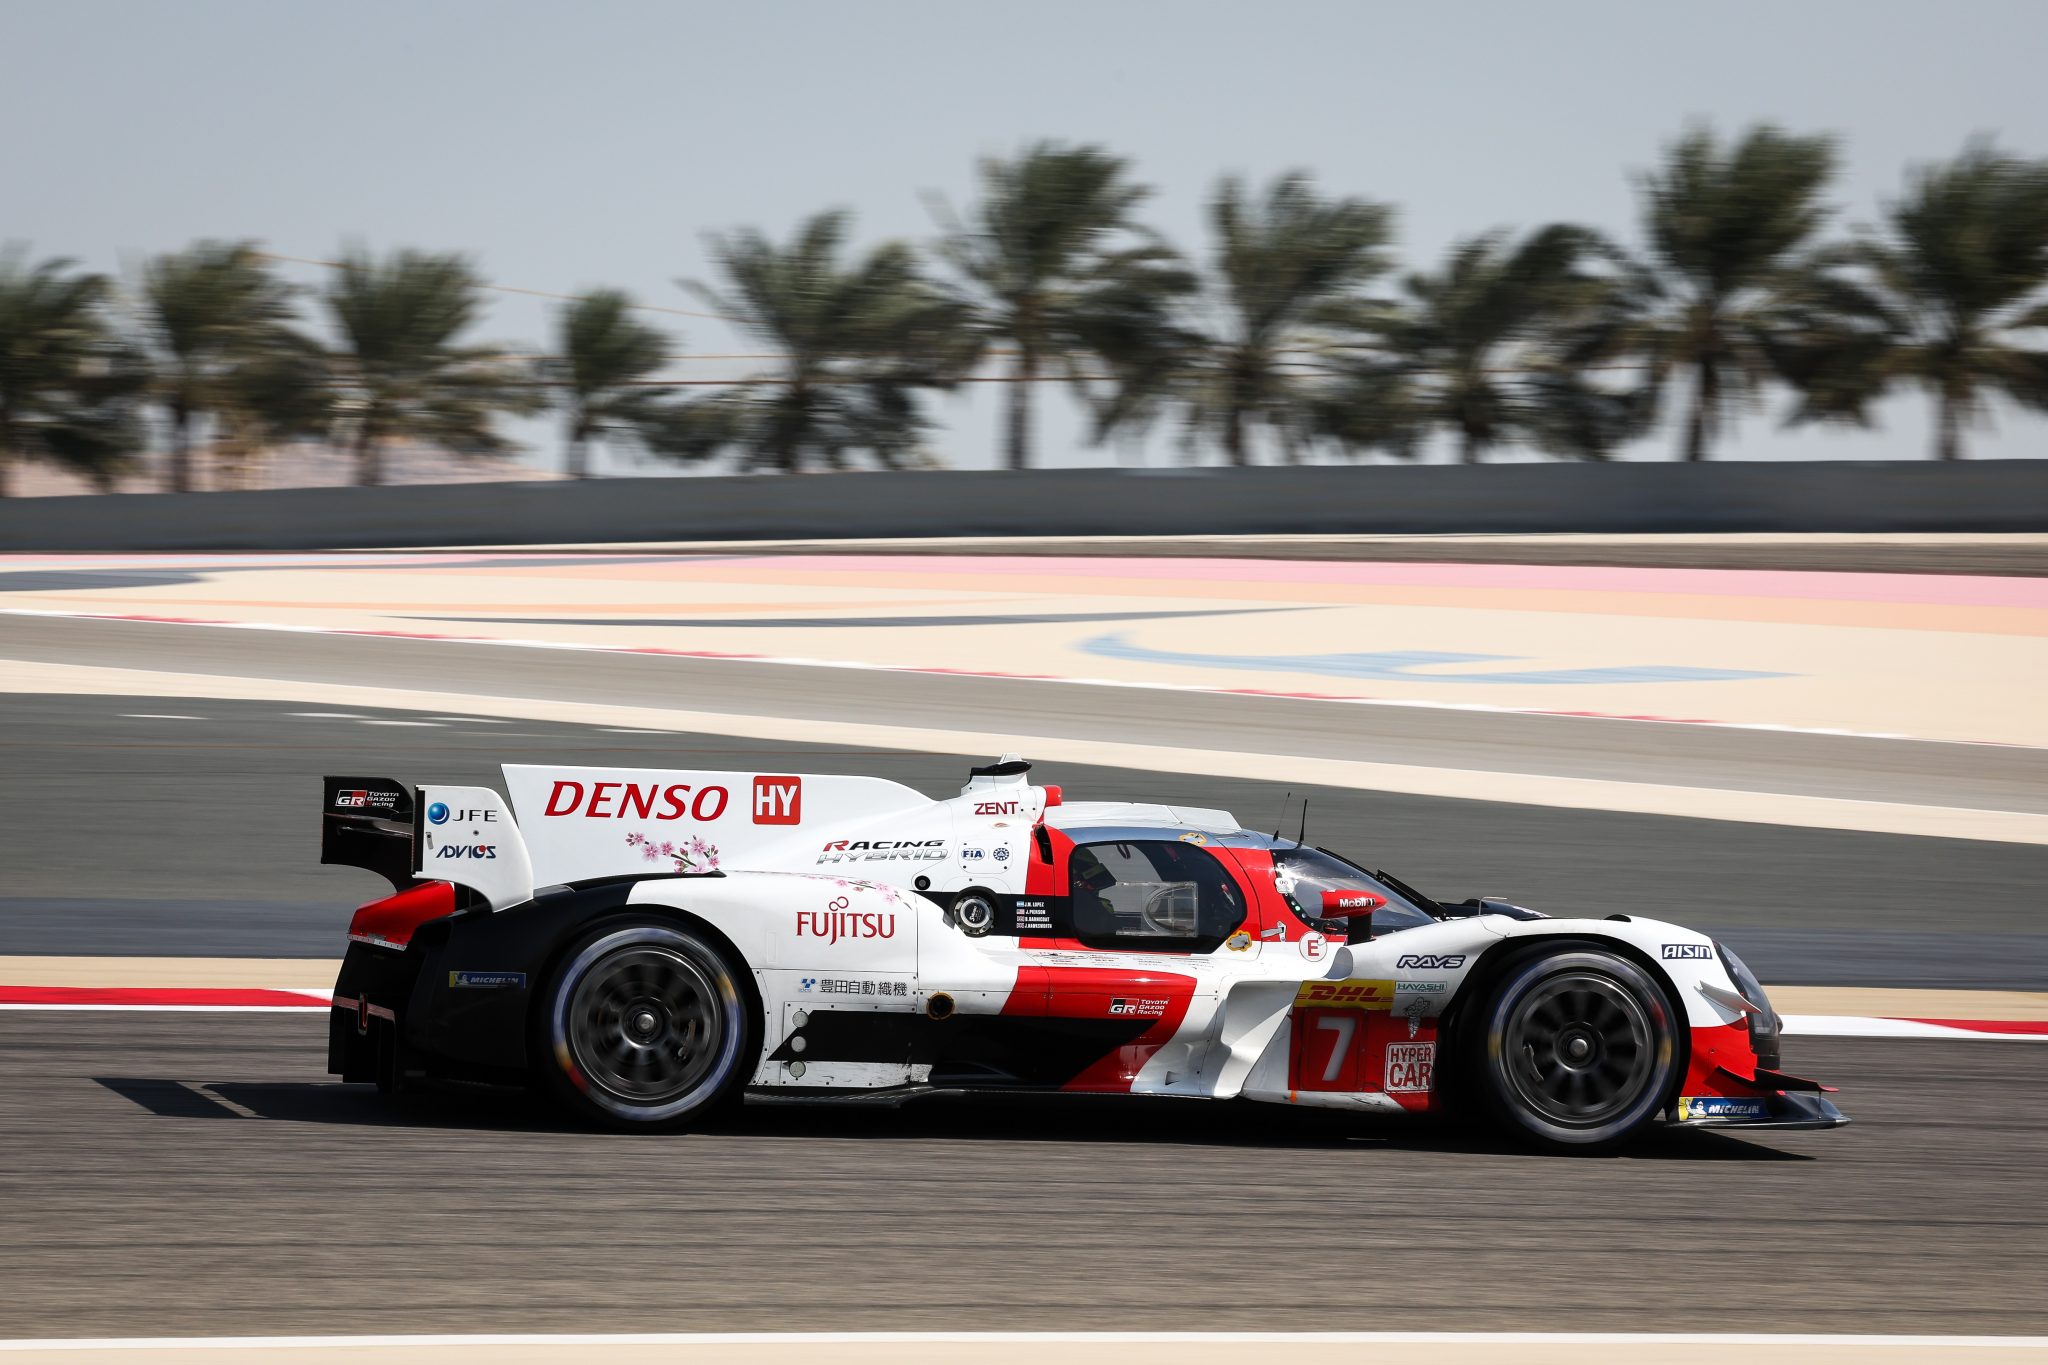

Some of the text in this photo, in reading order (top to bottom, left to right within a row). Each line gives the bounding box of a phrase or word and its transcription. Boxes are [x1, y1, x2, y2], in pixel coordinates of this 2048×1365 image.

[337, 796, 364, 805] GR
[544, 780, 729, 821] DENSO
[755, 783, 796, 817] HY
[452, 809, 498, 822] JFE
[973, 801, 1019, 815] ZENT
[436, 845, 497, 859] ADVICS
[822, 839, 946, 852] RACING
[815, 848, 949, 865] HYBRID
[1339, 897, 1366, 908] Mobil
[796, 911, 895, 946] FUJITSU
[1307, 939, 1320, 957] E
[1663, 944, 1712, 959] AISIN
[1396, 954, 1467, 969] RAYS
[819, 979, 908, 997] 豊田自動織機
[1308, 984, 1381, 1002] DHL
[1397, 983, 1445, 991] HAYASHI
[1110, 1004, 1136, 1014] GR
[1317, 1016, 1357, 1082] 7
[1390, 1047, 1432, 1062] HYPER
[1389, 1062, 1433, 1088] CAR
[1708, 1104, 1760, 1115] MICHELIN
